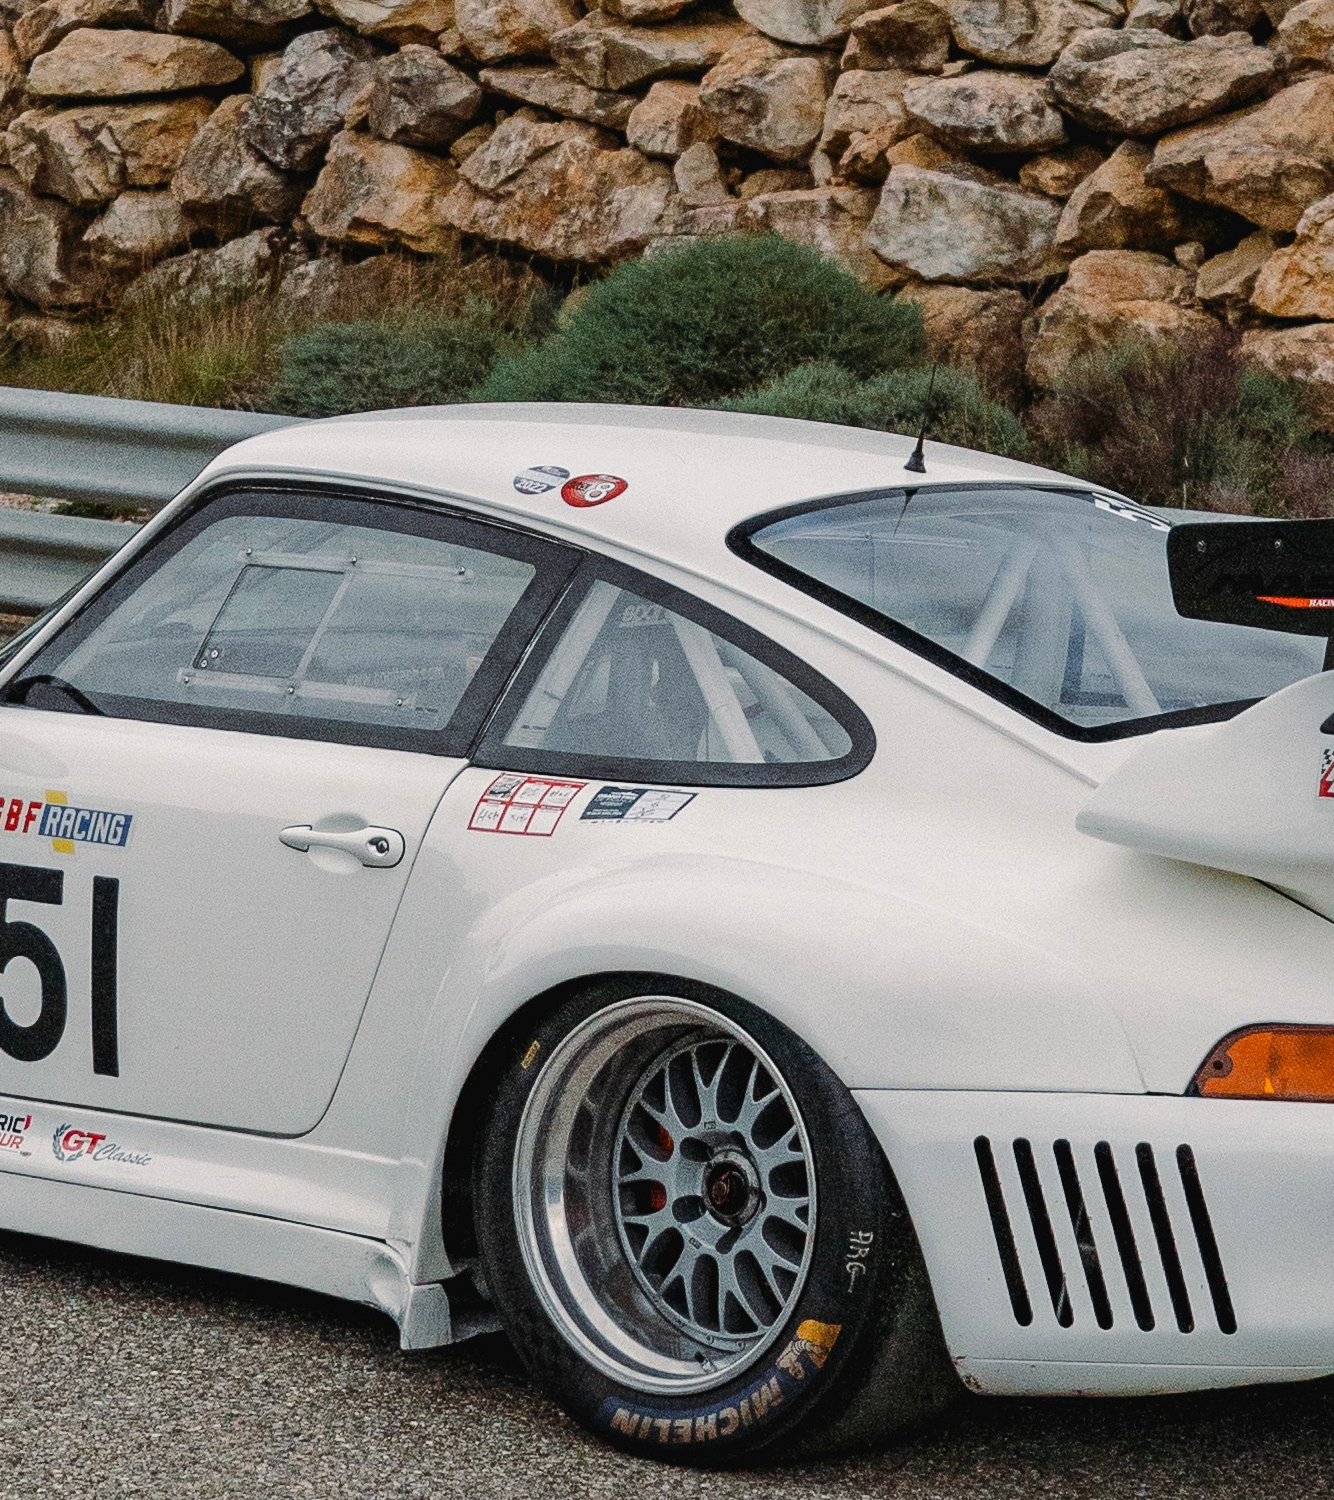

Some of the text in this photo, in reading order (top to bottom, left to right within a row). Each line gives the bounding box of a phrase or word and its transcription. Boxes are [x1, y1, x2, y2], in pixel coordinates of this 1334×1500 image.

[515, 478, 547, 493] 2022
[43, 805, 125, 845] RACING
[62, 1129, 152, 1166] GT Classic
[609, 1374, 785, 1445] MICHELIN
